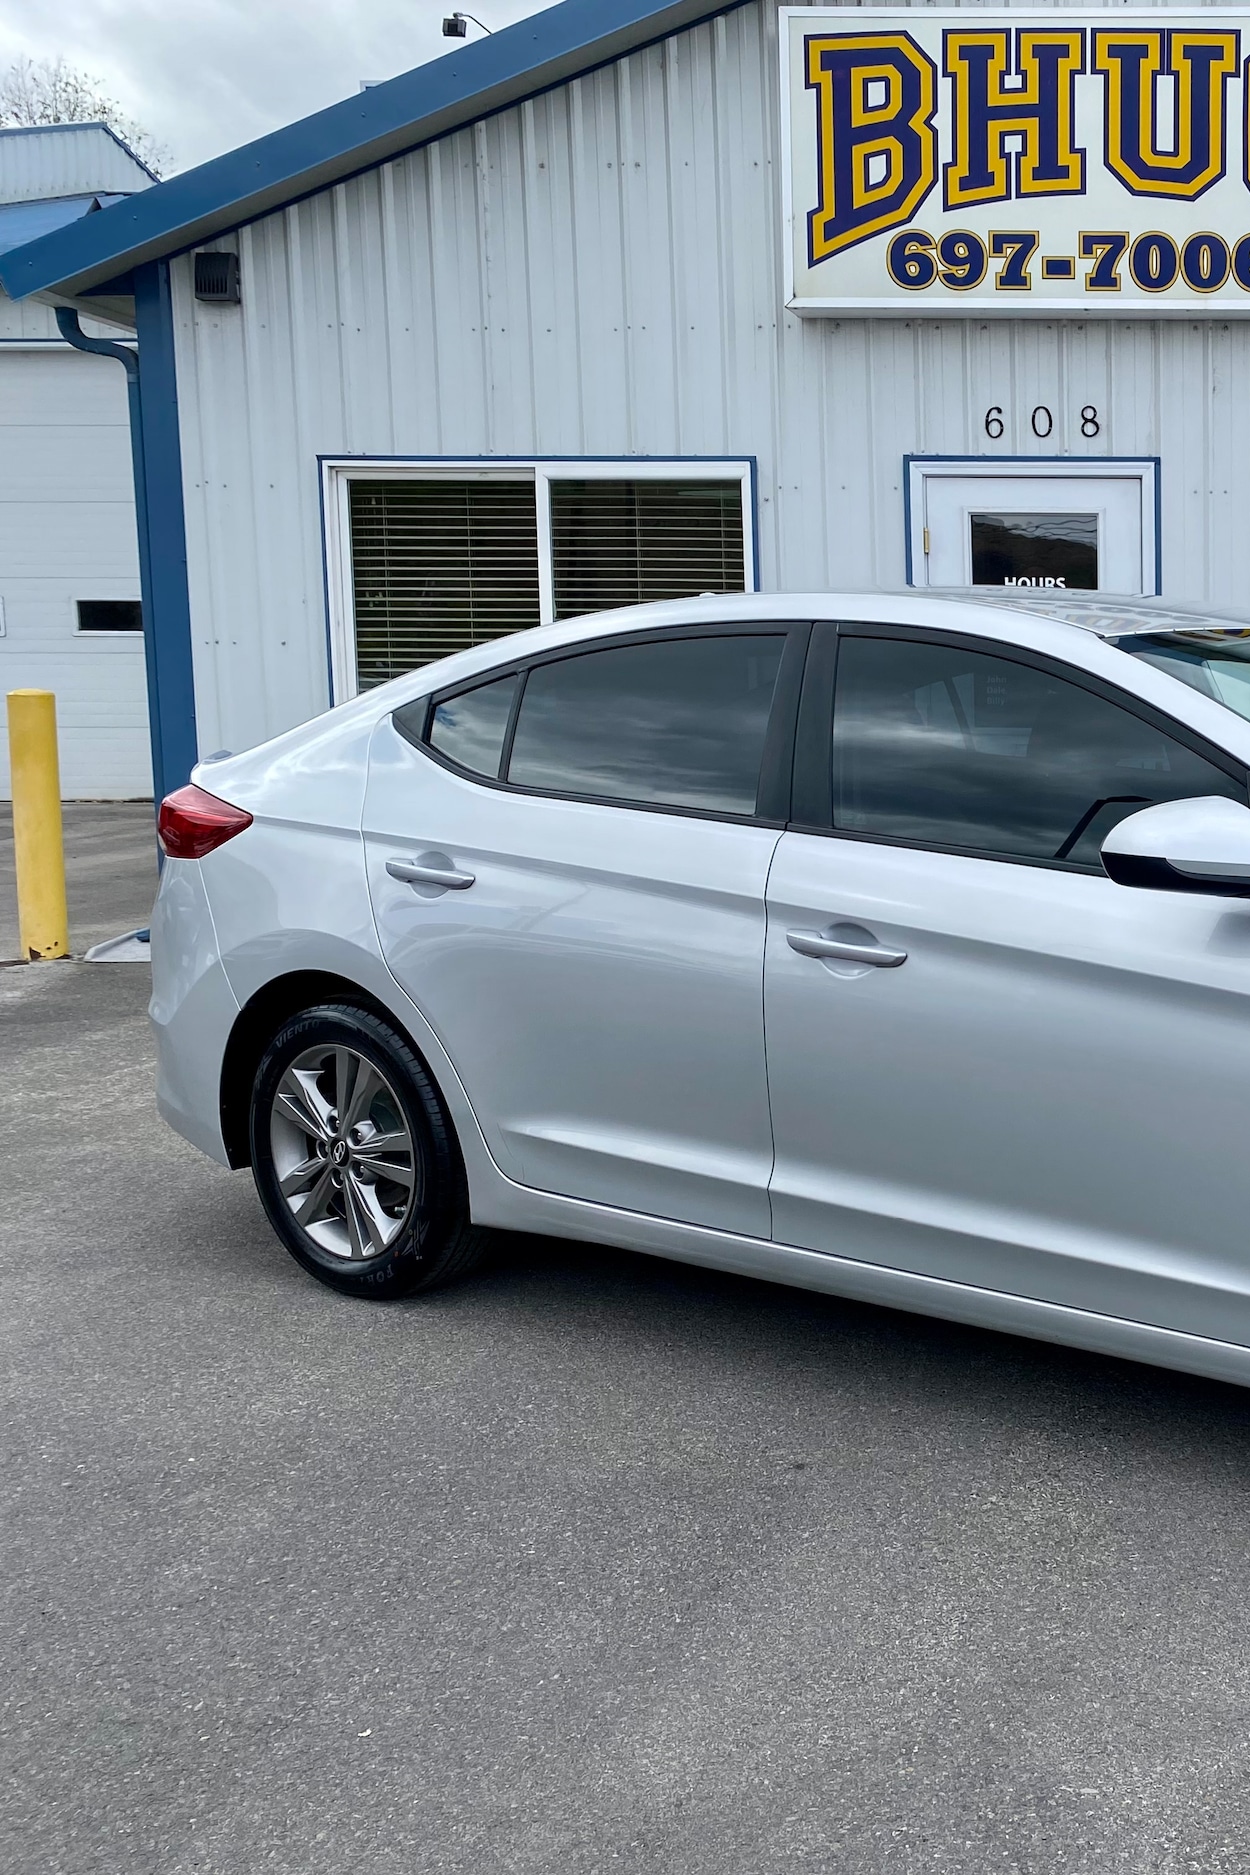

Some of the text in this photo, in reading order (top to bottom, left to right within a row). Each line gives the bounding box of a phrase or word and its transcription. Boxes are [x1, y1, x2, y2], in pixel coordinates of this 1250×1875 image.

[985, 405, 1100, 438] 608
[1004, 576, 1066, 589] HOURS
[275, 1019, 320, 1048] VIENTO
